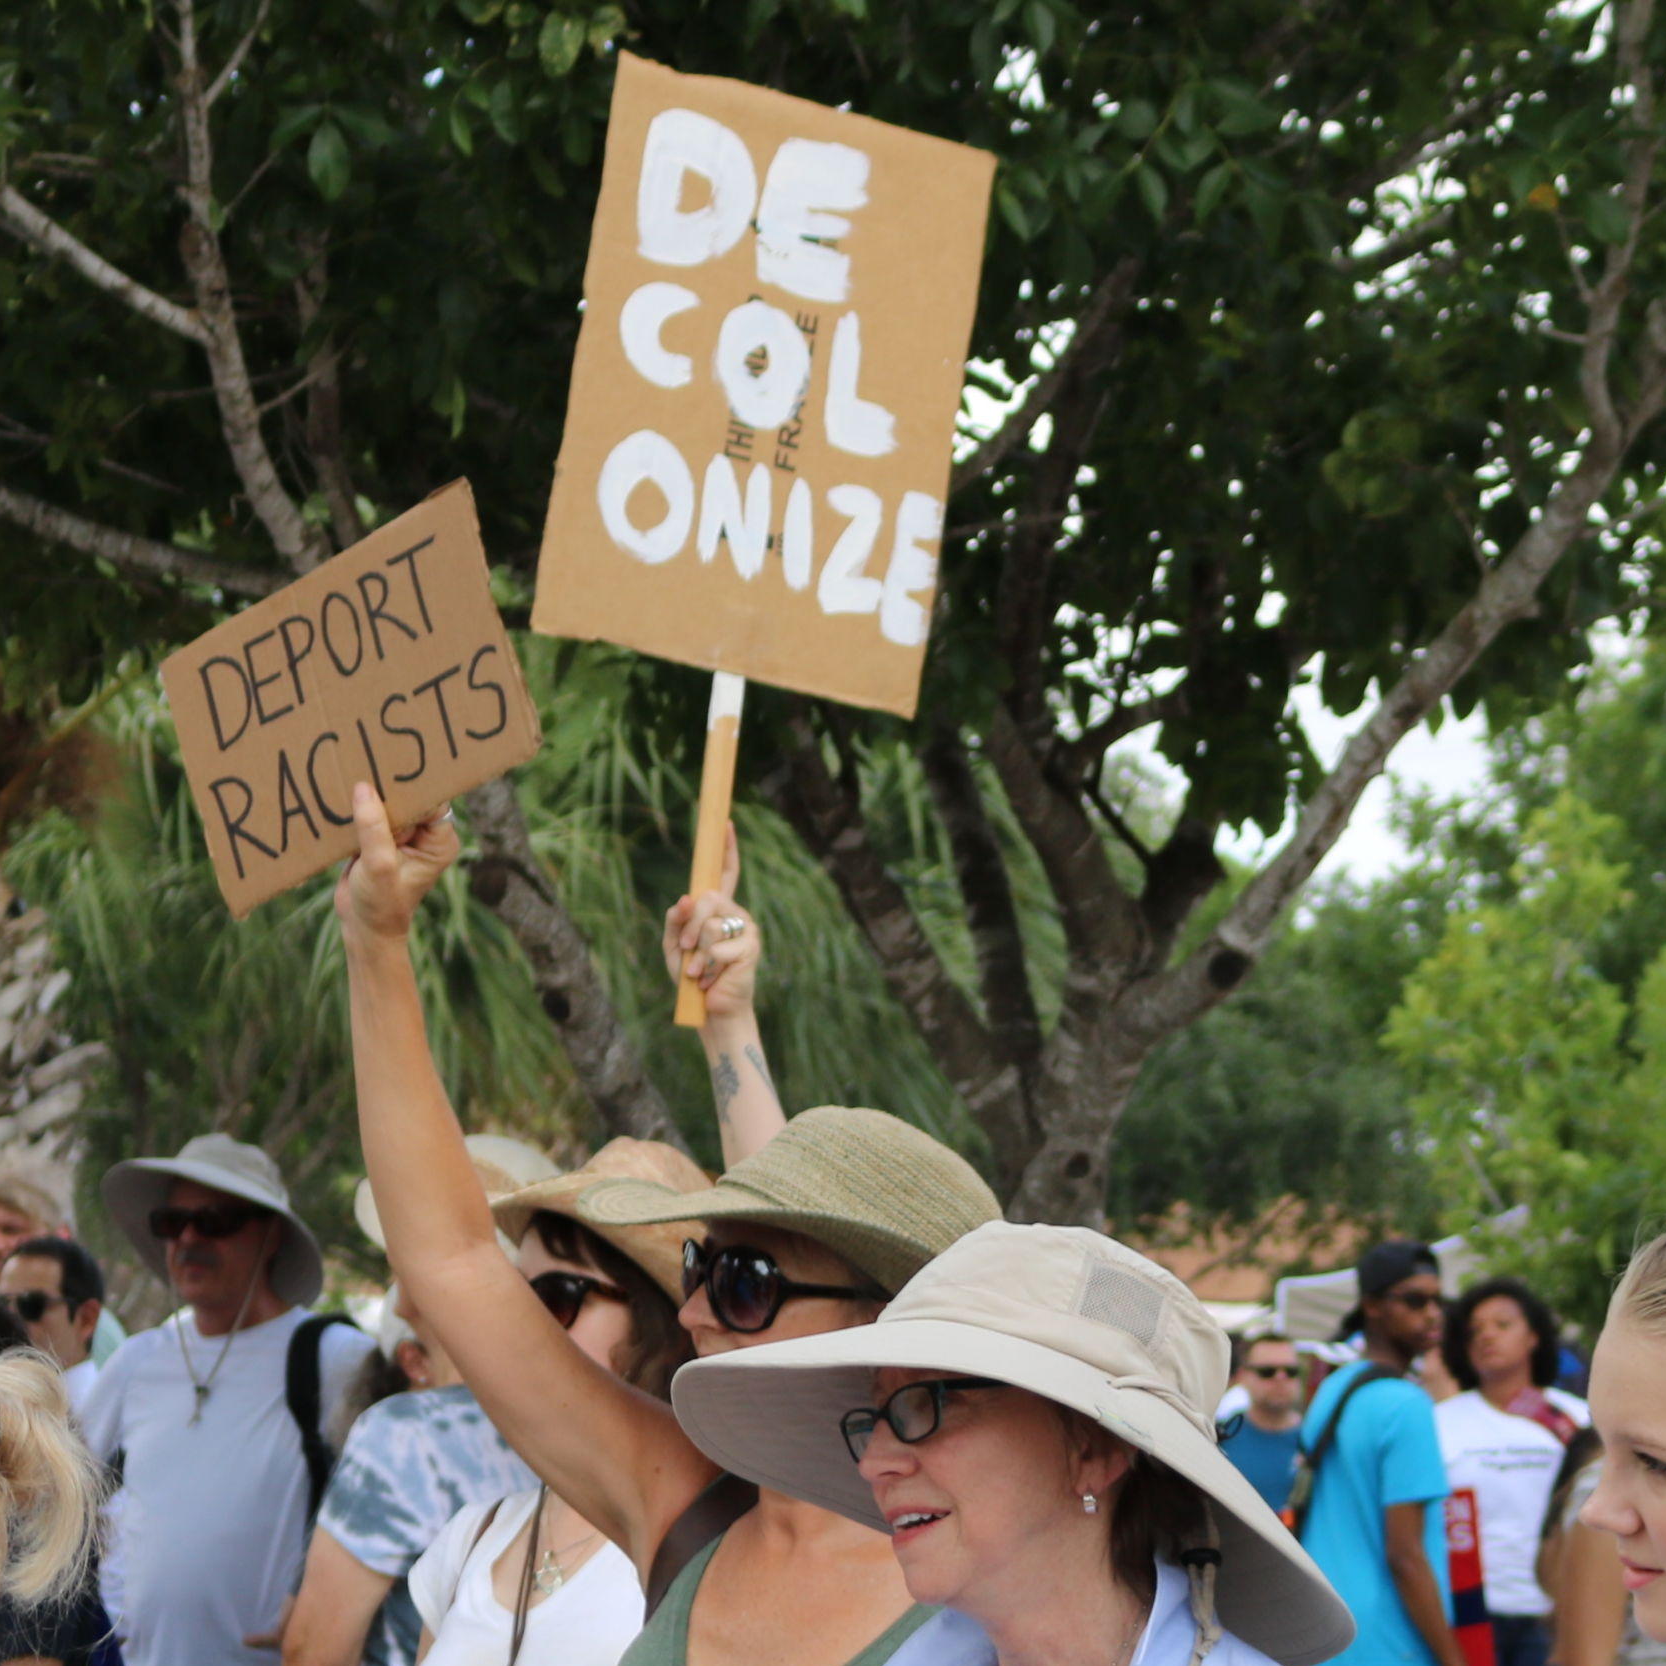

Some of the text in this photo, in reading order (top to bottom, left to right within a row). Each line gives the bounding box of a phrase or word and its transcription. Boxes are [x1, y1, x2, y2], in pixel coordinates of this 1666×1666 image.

[637, 108, 871, 303] DE
[619, 281, 896, 457] COL
[198, 535, 435, 754] DEPORT
[597, 428, 944, 647] ONIZE
[208, 645, 508, 879] RACISTS
